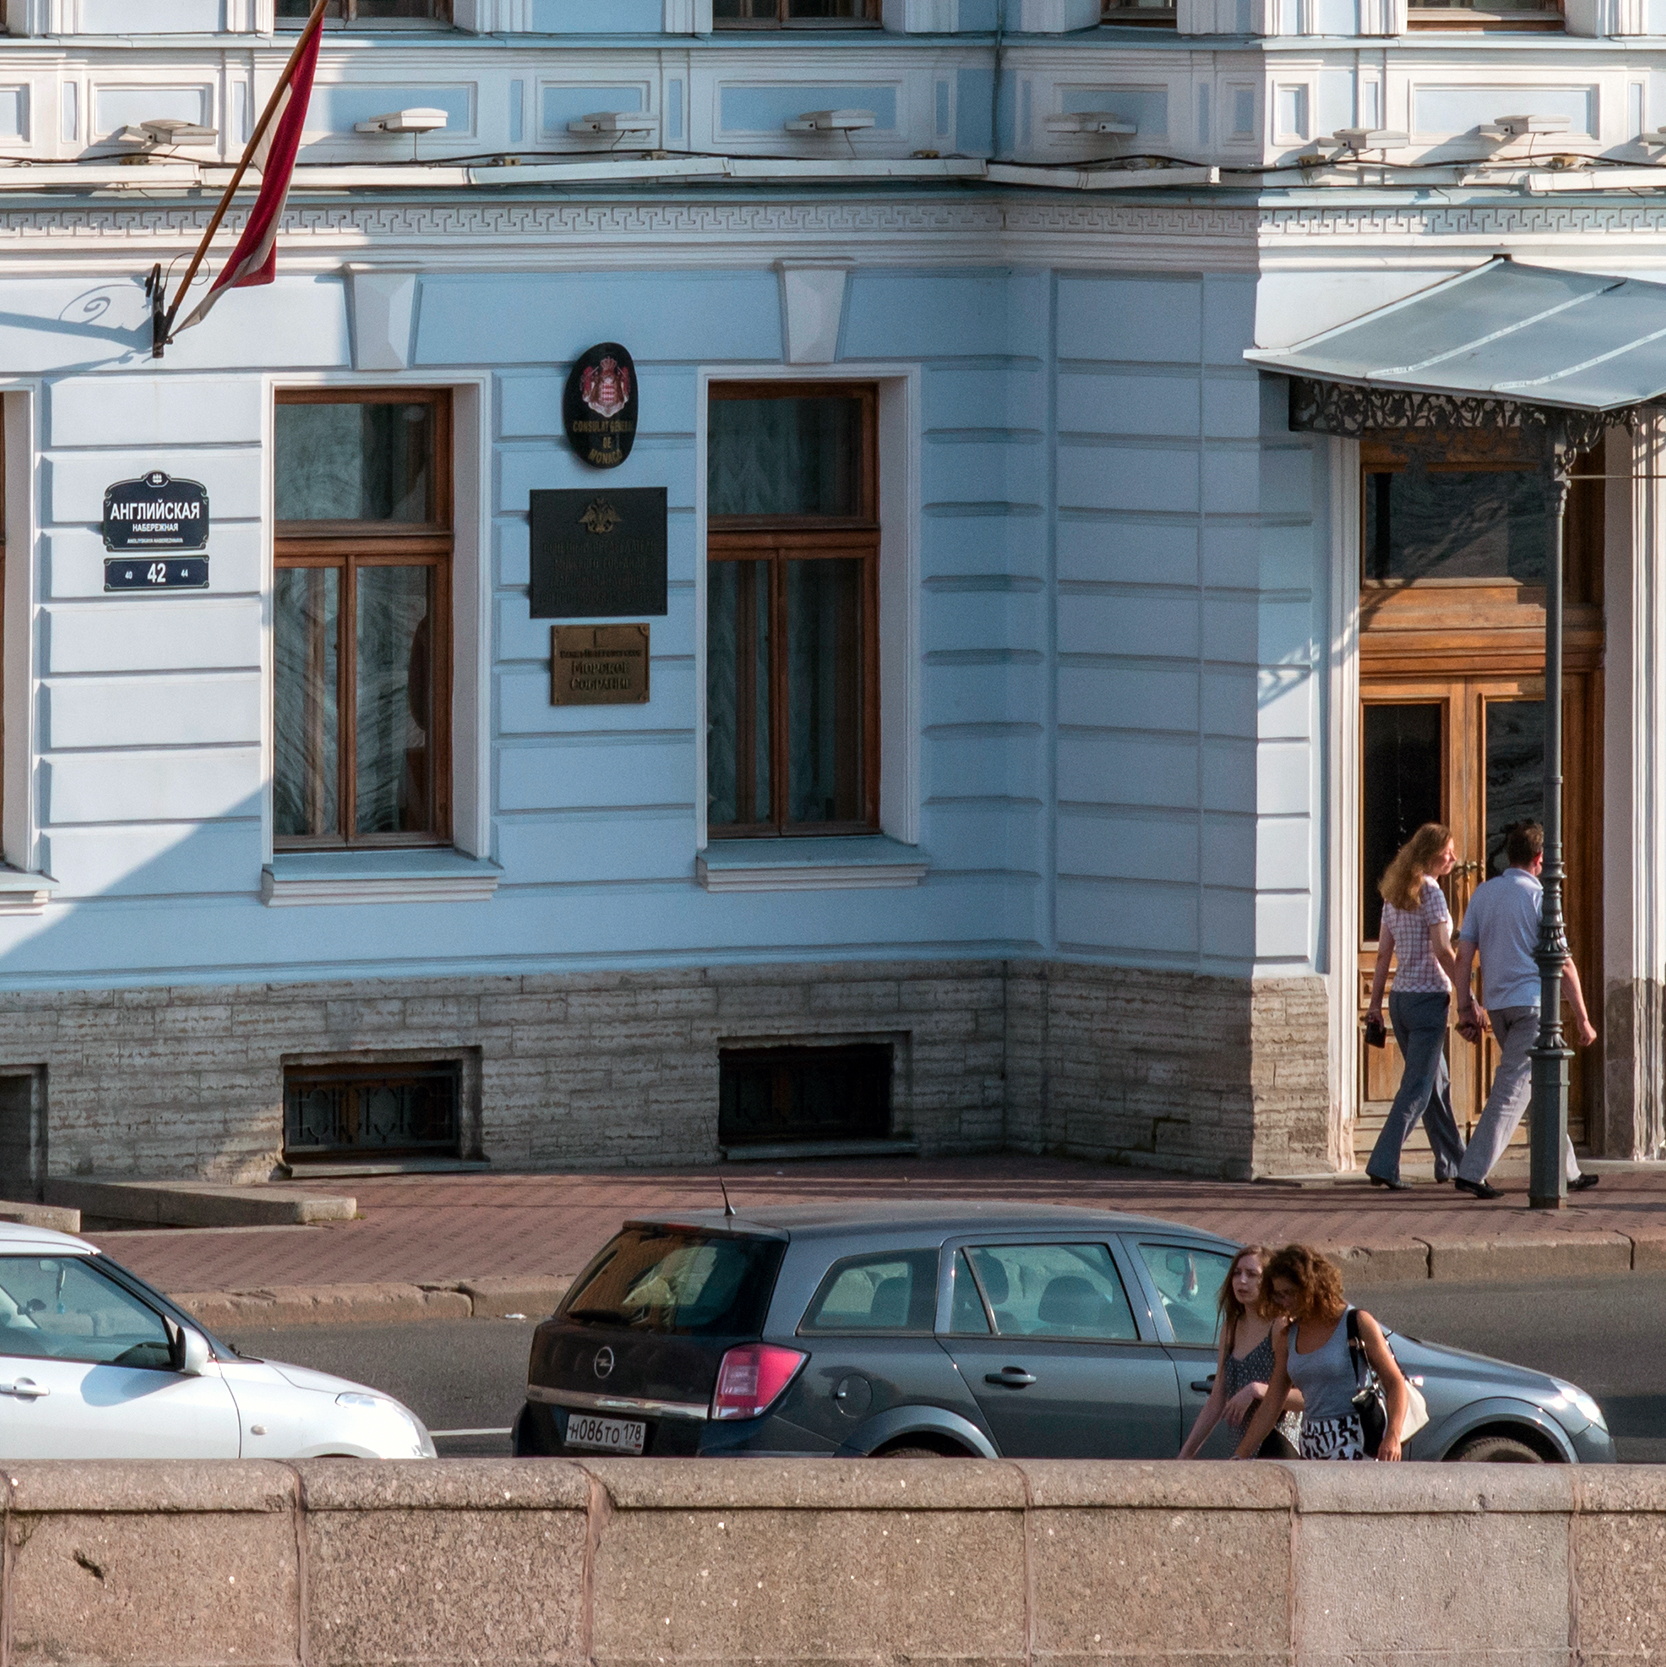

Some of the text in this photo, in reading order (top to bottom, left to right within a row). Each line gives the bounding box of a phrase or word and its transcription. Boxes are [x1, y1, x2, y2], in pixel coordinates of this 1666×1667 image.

[573, 420, 609, 433] CONSULAT
[588, 449, 622, 464] MONACO
[110, 498, 200, 521] АНГЛИЙСКАЯ
[132, 523, 179, 533] НАБЕРЕЖНАЯ
[147, 563, 166, 583] 42
[623, 1423, 642, 1441] 178
